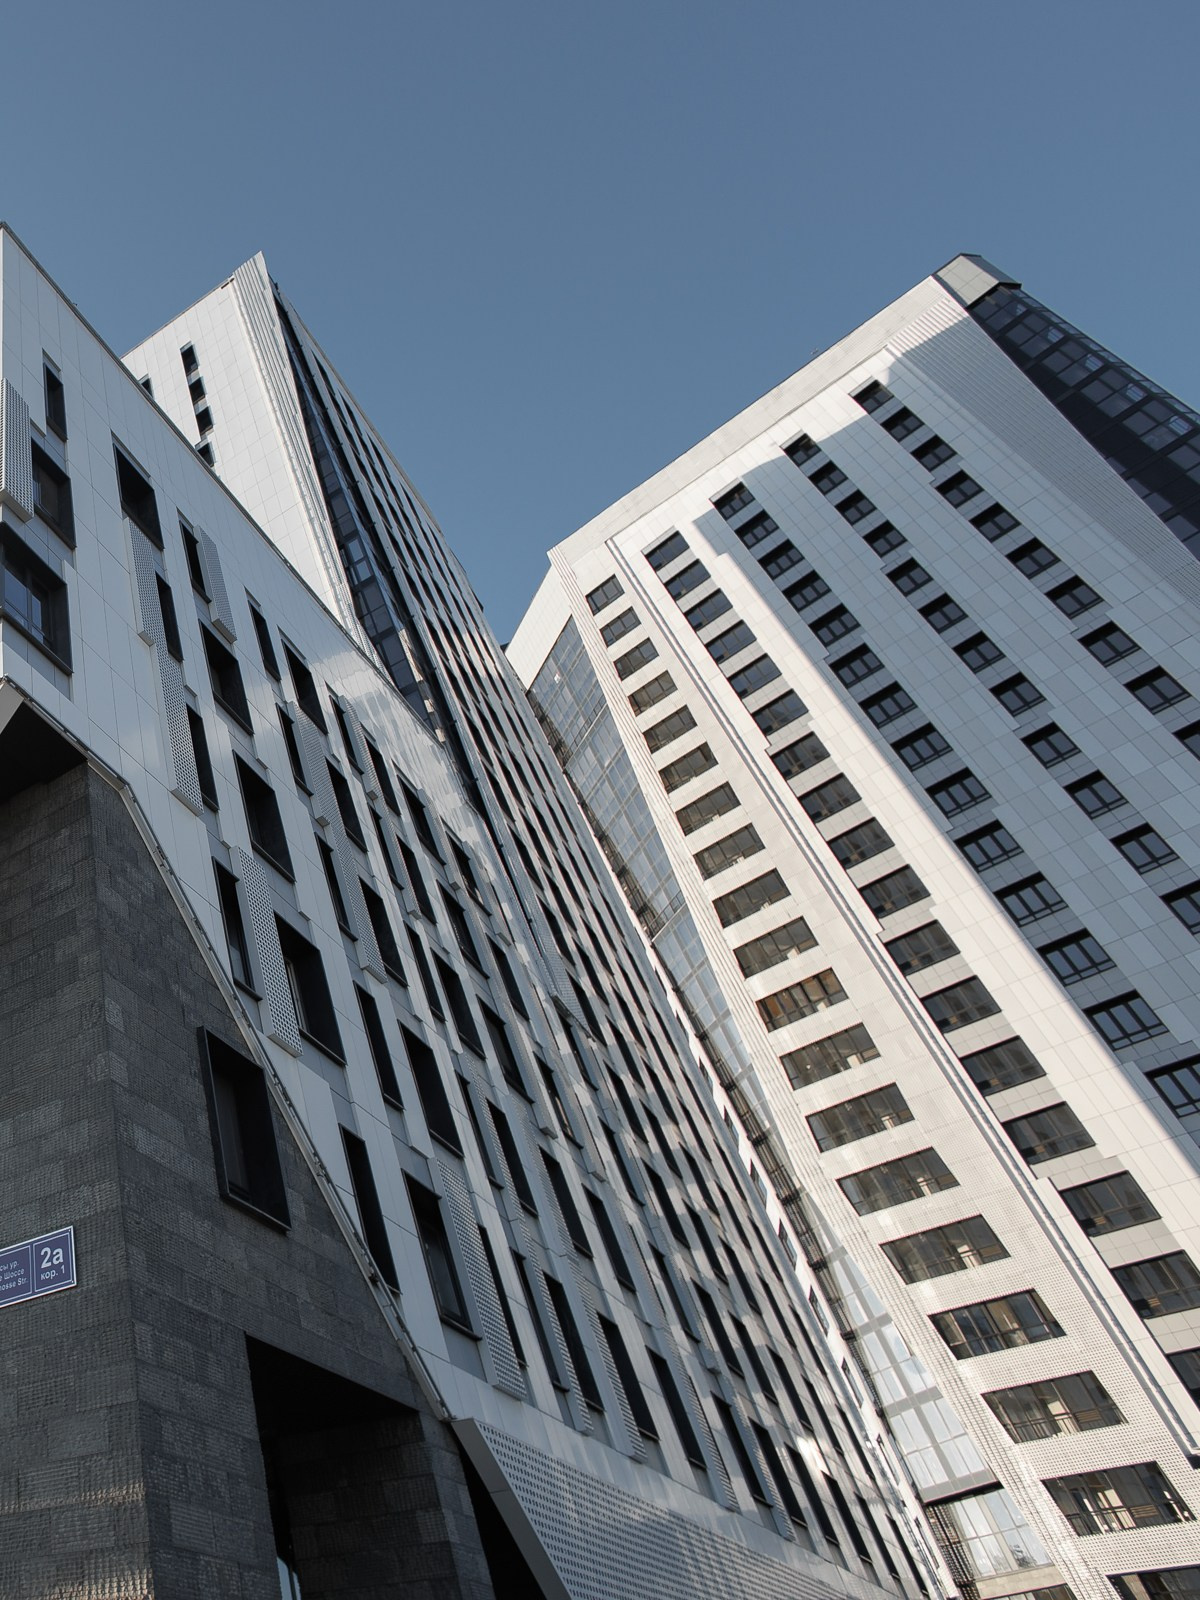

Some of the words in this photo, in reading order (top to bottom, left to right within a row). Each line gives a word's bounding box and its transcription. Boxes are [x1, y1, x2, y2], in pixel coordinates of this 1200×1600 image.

[40, 1247, 64, 1269] 2а
[3, 1268, 25, 1280] Шоссе
[40, 1270, 59, 1280] кор.
